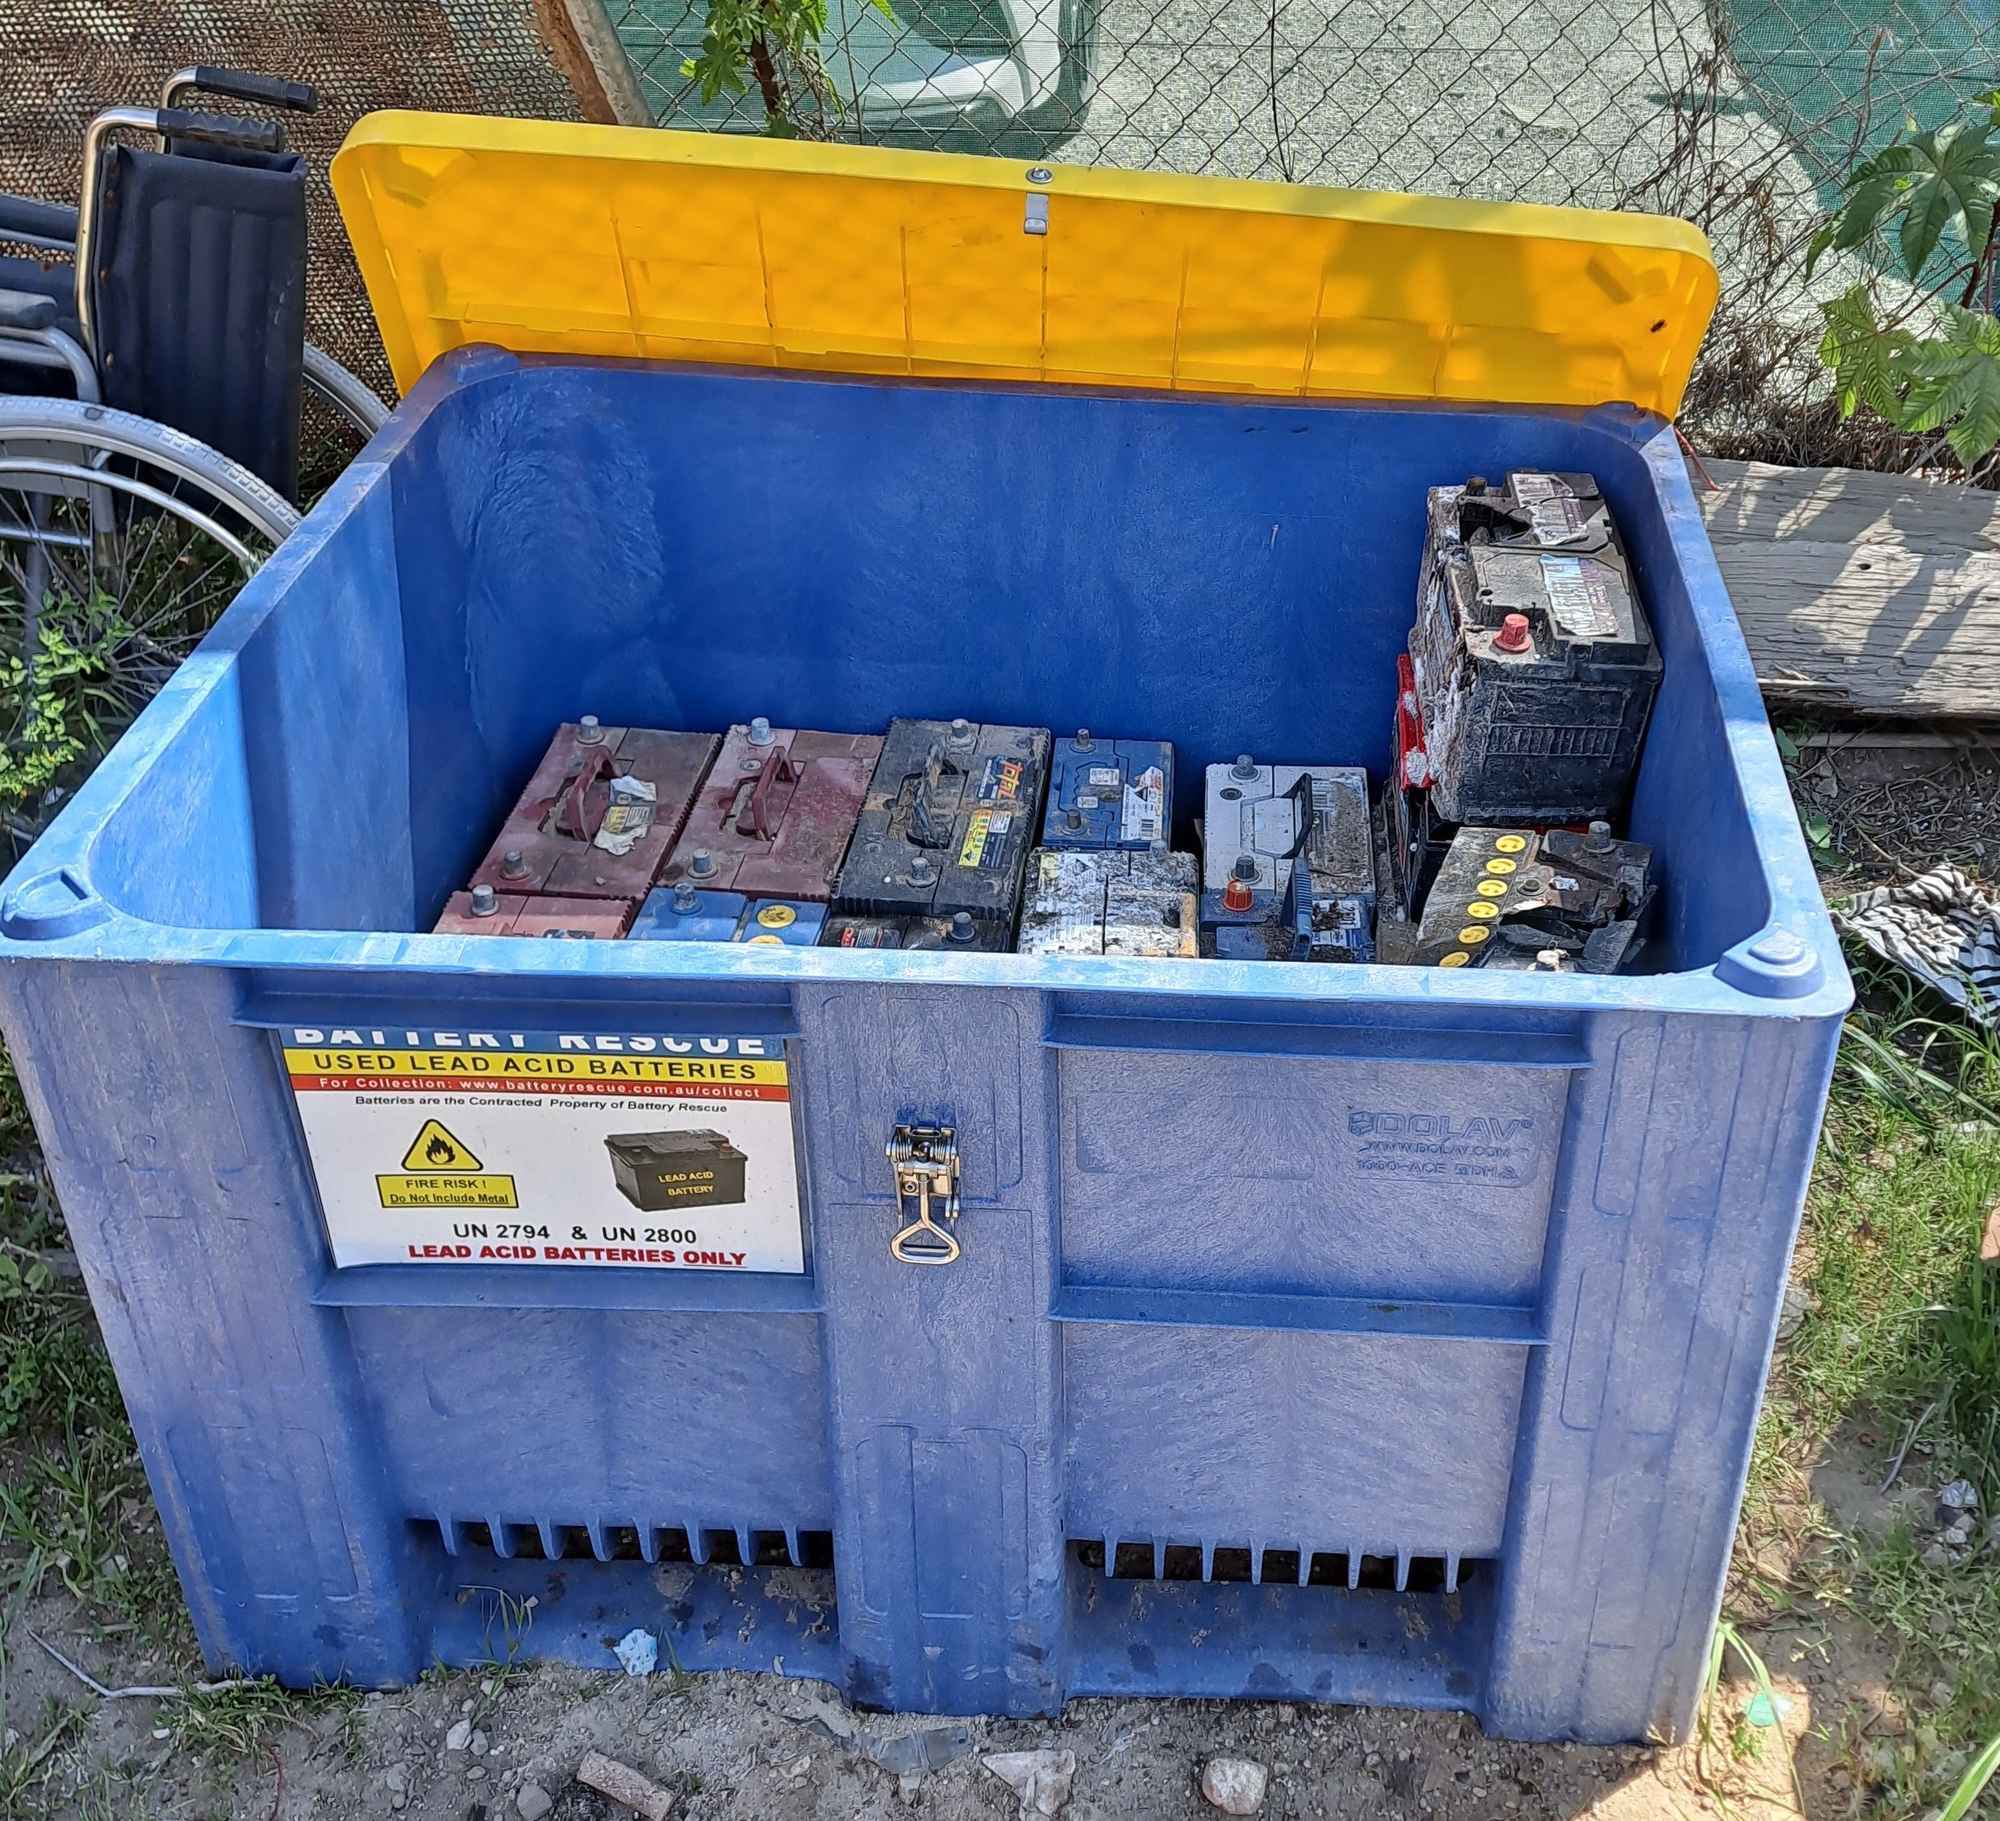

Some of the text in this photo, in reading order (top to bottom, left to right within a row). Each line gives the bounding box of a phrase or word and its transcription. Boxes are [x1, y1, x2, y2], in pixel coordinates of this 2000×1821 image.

[313, 1054, 757, 1079] USED LEAD ACID BATTERIES
[319, 1077, 760, 1098] For Collection: www.batteryrescue.com.au/collect
[355, 1096, 415, 1105] Batteries
[444, 1096, 465, 1106] the
[469, 1096, 542, 1107] Contracted
[550, 1098, 607, 1110] Property
[611, 1100, 625, 1109] of
[628, 1101, 675, 1113] Battery
[679, 1103, 728, 1113] Rescue
[1375, 1112, 1521, 1142] DOLAV
[405, 1179, 439, 1188] FIRE
[444, 1179, 478, 1189] RISK
[658, 1171, 714, 1184] LEAD ACID
[390, 1193, 509, 1204] Do Not Include Metal
[667, 1185, 714, 1196] BATTERY
[453, 1223, 697, 1243] UN 2794 & UN 2800
[408, 1245, 747, 1267] LEAD ACID BATTERIES ONLY
